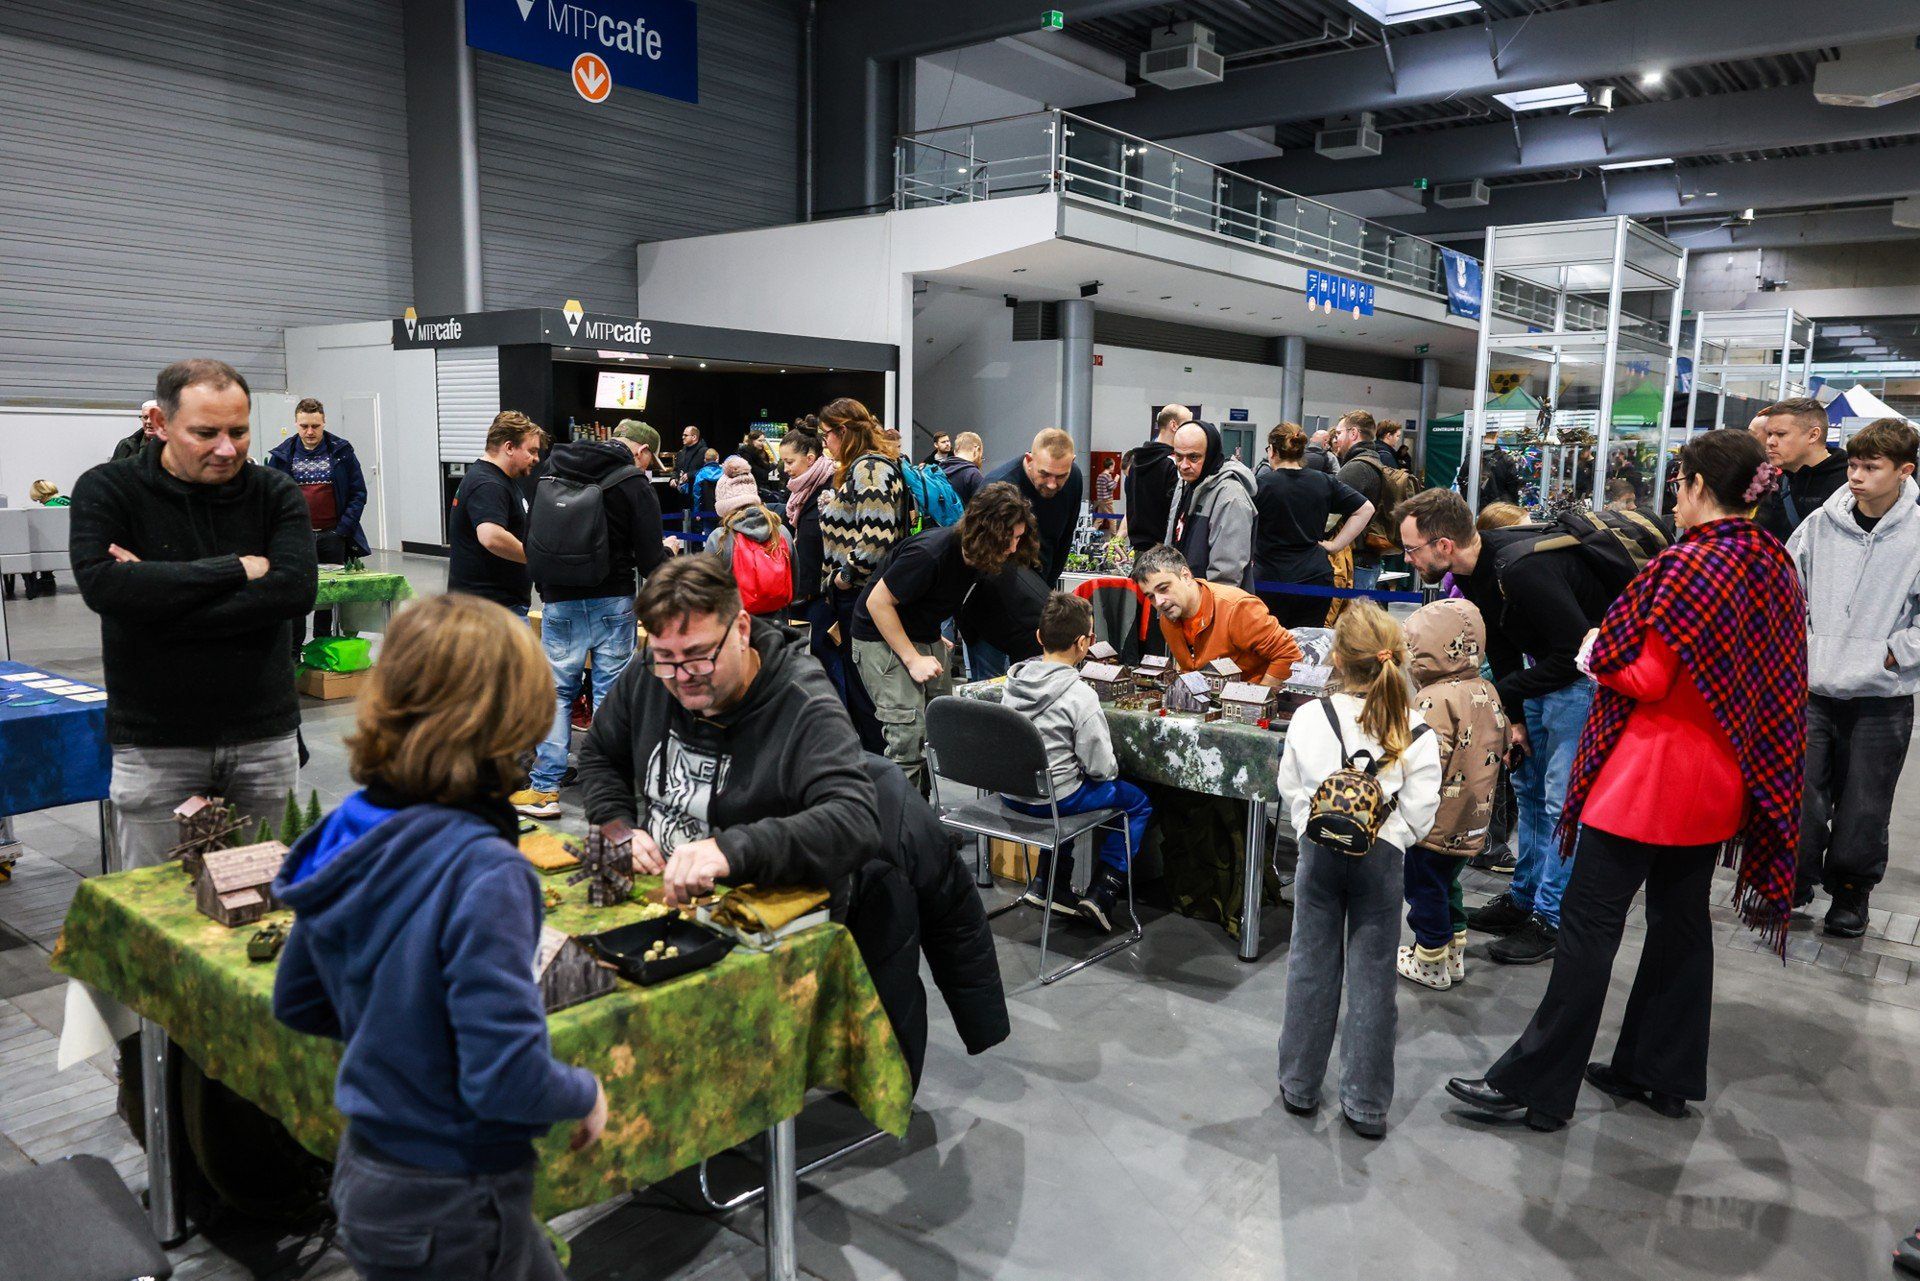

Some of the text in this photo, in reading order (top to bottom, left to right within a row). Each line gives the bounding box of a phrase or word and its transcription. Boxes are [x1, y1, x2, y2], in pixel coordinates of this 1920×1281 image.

[548, 0, 662, 60] MTPcafe
[418, 318, 462, 341] MTPcafe
[585, 322, 651, 344] MTPcafe
